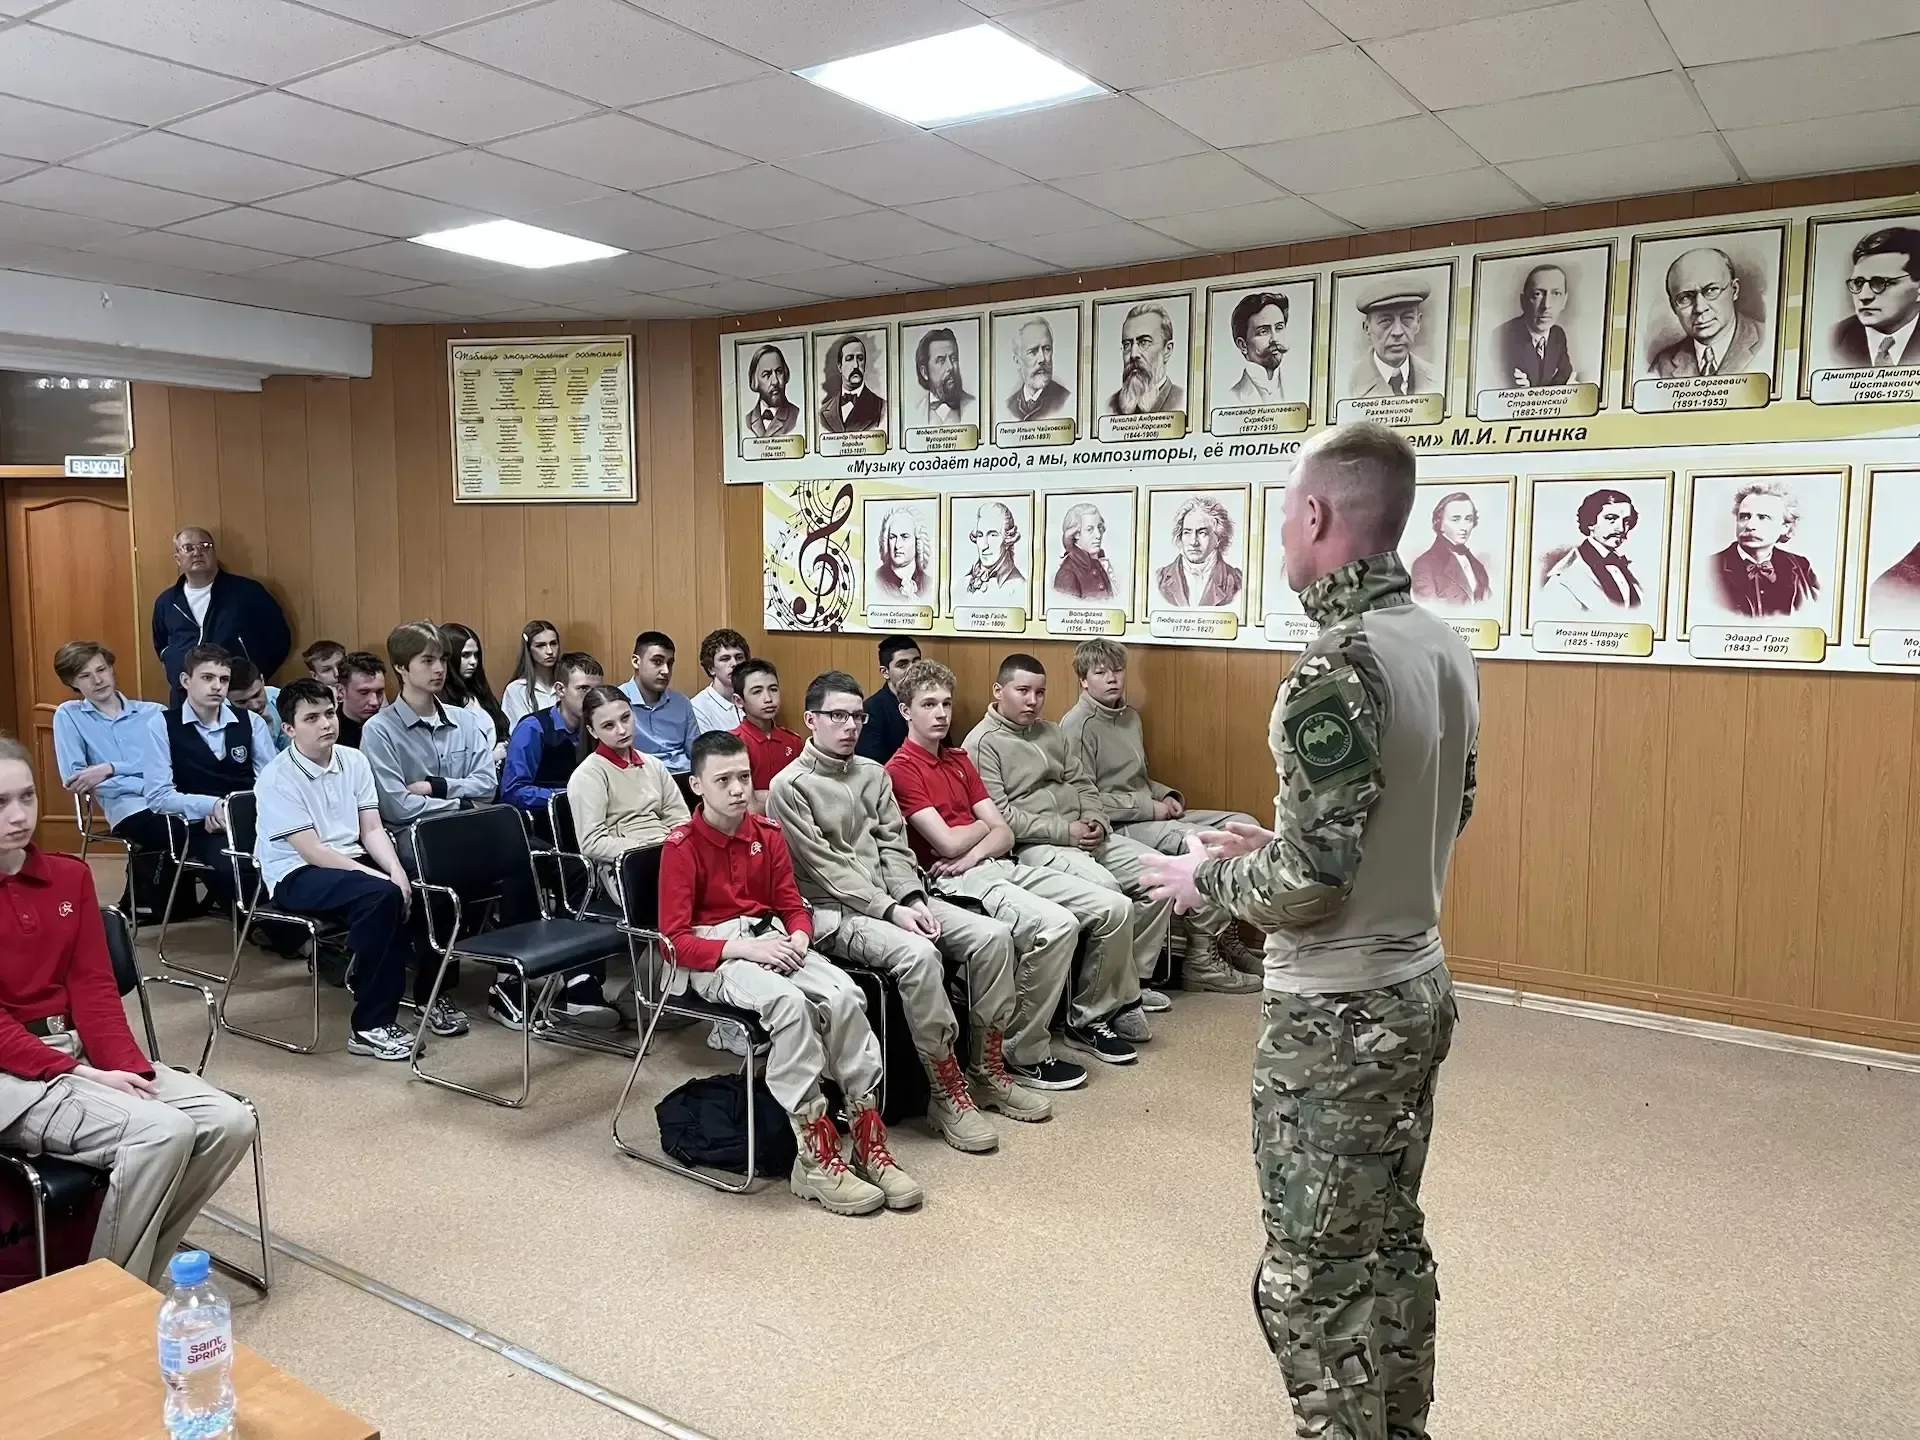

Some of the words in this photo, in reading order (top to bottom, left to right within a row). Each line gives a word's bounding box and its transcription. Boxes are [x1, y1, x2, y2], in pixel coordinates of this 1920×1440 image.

[1821, 370, 1875, 381] Дмитрий
[1655, 379, 1691, 390] Сергей
[1692, 376, 1748, 388] Сергеевич
[1849, 380, 1920, 390] Шостакович
[1498, 390, 1525, 399] Игорь
[1527, 387, 1578, 398] Федорович
[1671, 388, 1729, 400] Прокофьев
[1854, 389, 1914, 401] (1906-1975)
[1351, 401, 1379, 409] Сергей
[1381, 397, 1430, 406] Васильевич
[1507, 397, 1568, 407] Стравинский
[1672, 398, 1728, 409] (1891-1953)
[1218, 408, 1256, 417] Александр
[1257, 406, 1301, 415] Николаевич
[1365, 407, 1414, 416] Рахманинов
[1512, 406, 1561, 418] (1882-1971)
[1110, 415, 1137, 423] Николай
[1138, 414, 1175, 423] Андреевич
[1243, 416, 1274, 424] Скрябин
[939, 427, 968, 436] Петрович
[1037, 423, 1072, 432] Чайковский
[1112, 423, 1172, 431] Римский-Корсаков
[1239, 424, 1278, 433] (1872-1915)
[1451, 427, 1497, 446] М.И.
[1505, 426, 1588, 444] Глинка
[847, 459, 906, 475] «Музыку
[909, 456, 969, 471] создаёт
[973, 452, 1021, 470] народ,
[1025, 455, 1035, 466] а
[1038, 453, 1067, 467] мы,
[1072, 447, 1198, 464] композиторы,
[1203, 442, 1224, 458] её
[1229, 441, 1301, 457] только
[72, 460, 119, 473] ВЫХОД
[1085, 618, 1111, 626] Моцарт
[1156, 617, 1182, 625] Людвиг
[1197, 617, 1232, 625] Бетховен
[1284, 620, 1308, 628] Франц
[1066, 625, 1082, 633] (1756
[1172, 625, 1189, 633] (1770
[1197, 626, 1214, 634] 1827)
[1555, 629, 1588, 638] Иоганн
[1590, 630, 1629, 639] Штраус
[1564, 638, 1588, 647] (1825
[1595, 639, 1619, 648] 1899)
[1725, 633, 1763, 643] Эдвард
[1765, 634, 1790, 643] Григ
[1724, 643, 1751, 653] (1843
[1763, 644, 1789, 654] 1907)
[187, 1343, 227, 1364] SPRING
